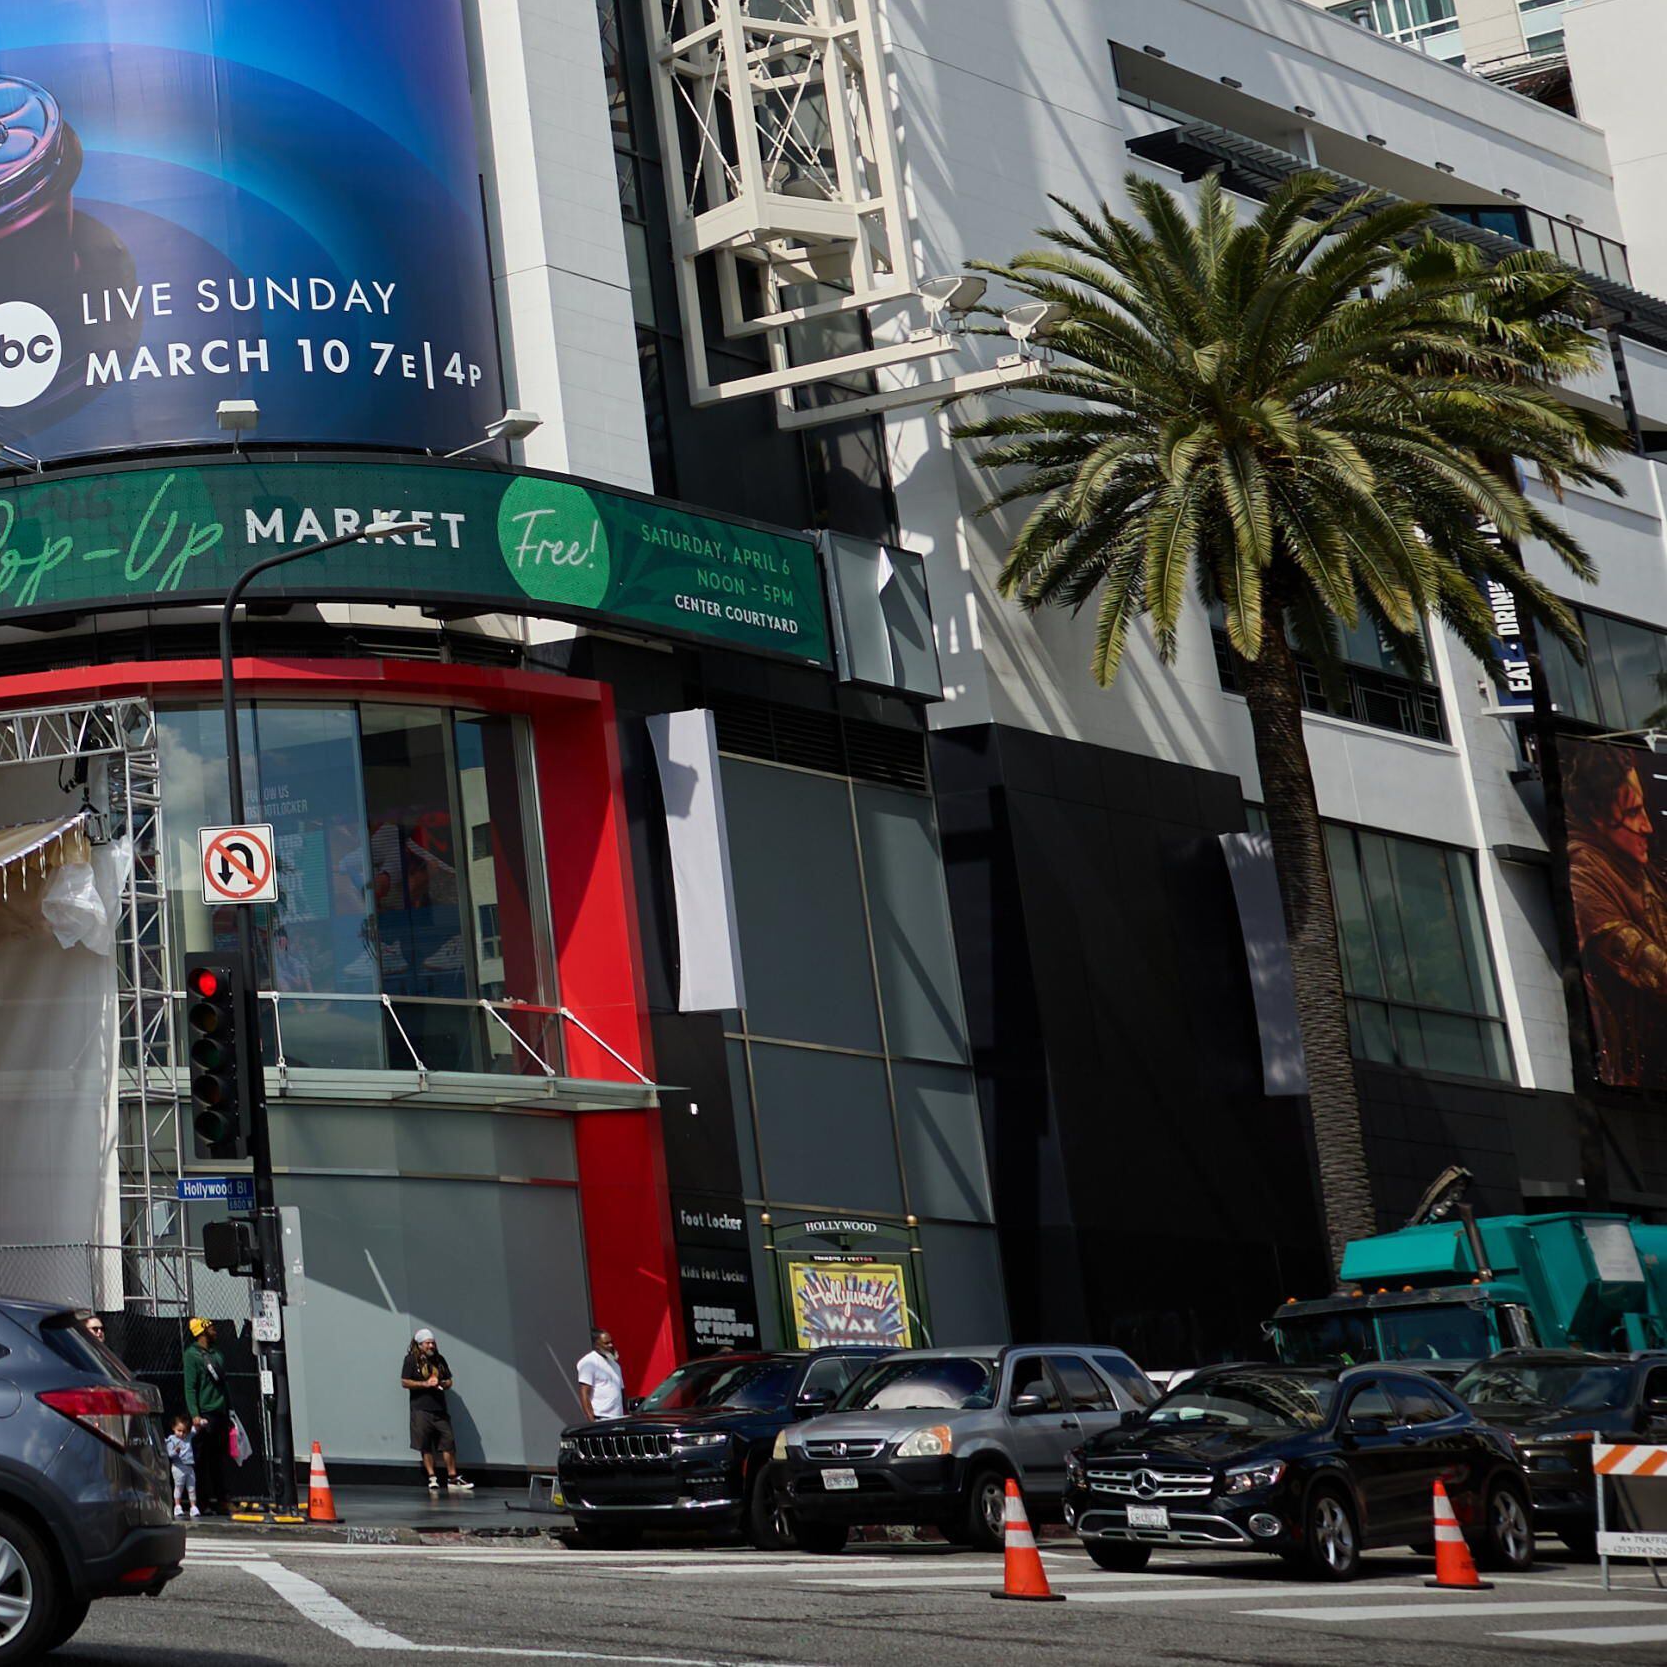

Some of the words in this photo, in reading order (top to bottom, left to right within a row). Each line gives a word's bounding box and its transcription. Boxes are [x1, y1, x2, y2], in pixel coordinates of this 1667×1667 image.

[82, 282, 173, 325] LIVE
[196, 277, 396, 315] SUNDAY
[85, 339, 269, 387] MARCH
[297, 338, 350, 374] 10
[511, 509, 599, 570] Free!
[641, 524, 728, 564] SATURDAY,
[733, 548, 780, 574] APRIL
[782, 558, 792, 576] 6
[696, 568, 745, 594] NOON
[763, 583, 795, 607] 5PM
[674, 594, 722, 620] CENTER
[724, 604, 798, 634] COURTYARD
[1503, 659, 1533, 692] EAT
[183, 1182, 233, 1199] Hollywood
[236, 1181, 247, 1194] Bl
[680, 1210, 704, 1227] Foot
[707, 1213, 742, 1231] Locker
[805, 1221, 877, 1232] HOLLYWOOD
[805, 1279, 886, 1318] Hollywood
[825, 1312, 877, 1334] WAX
